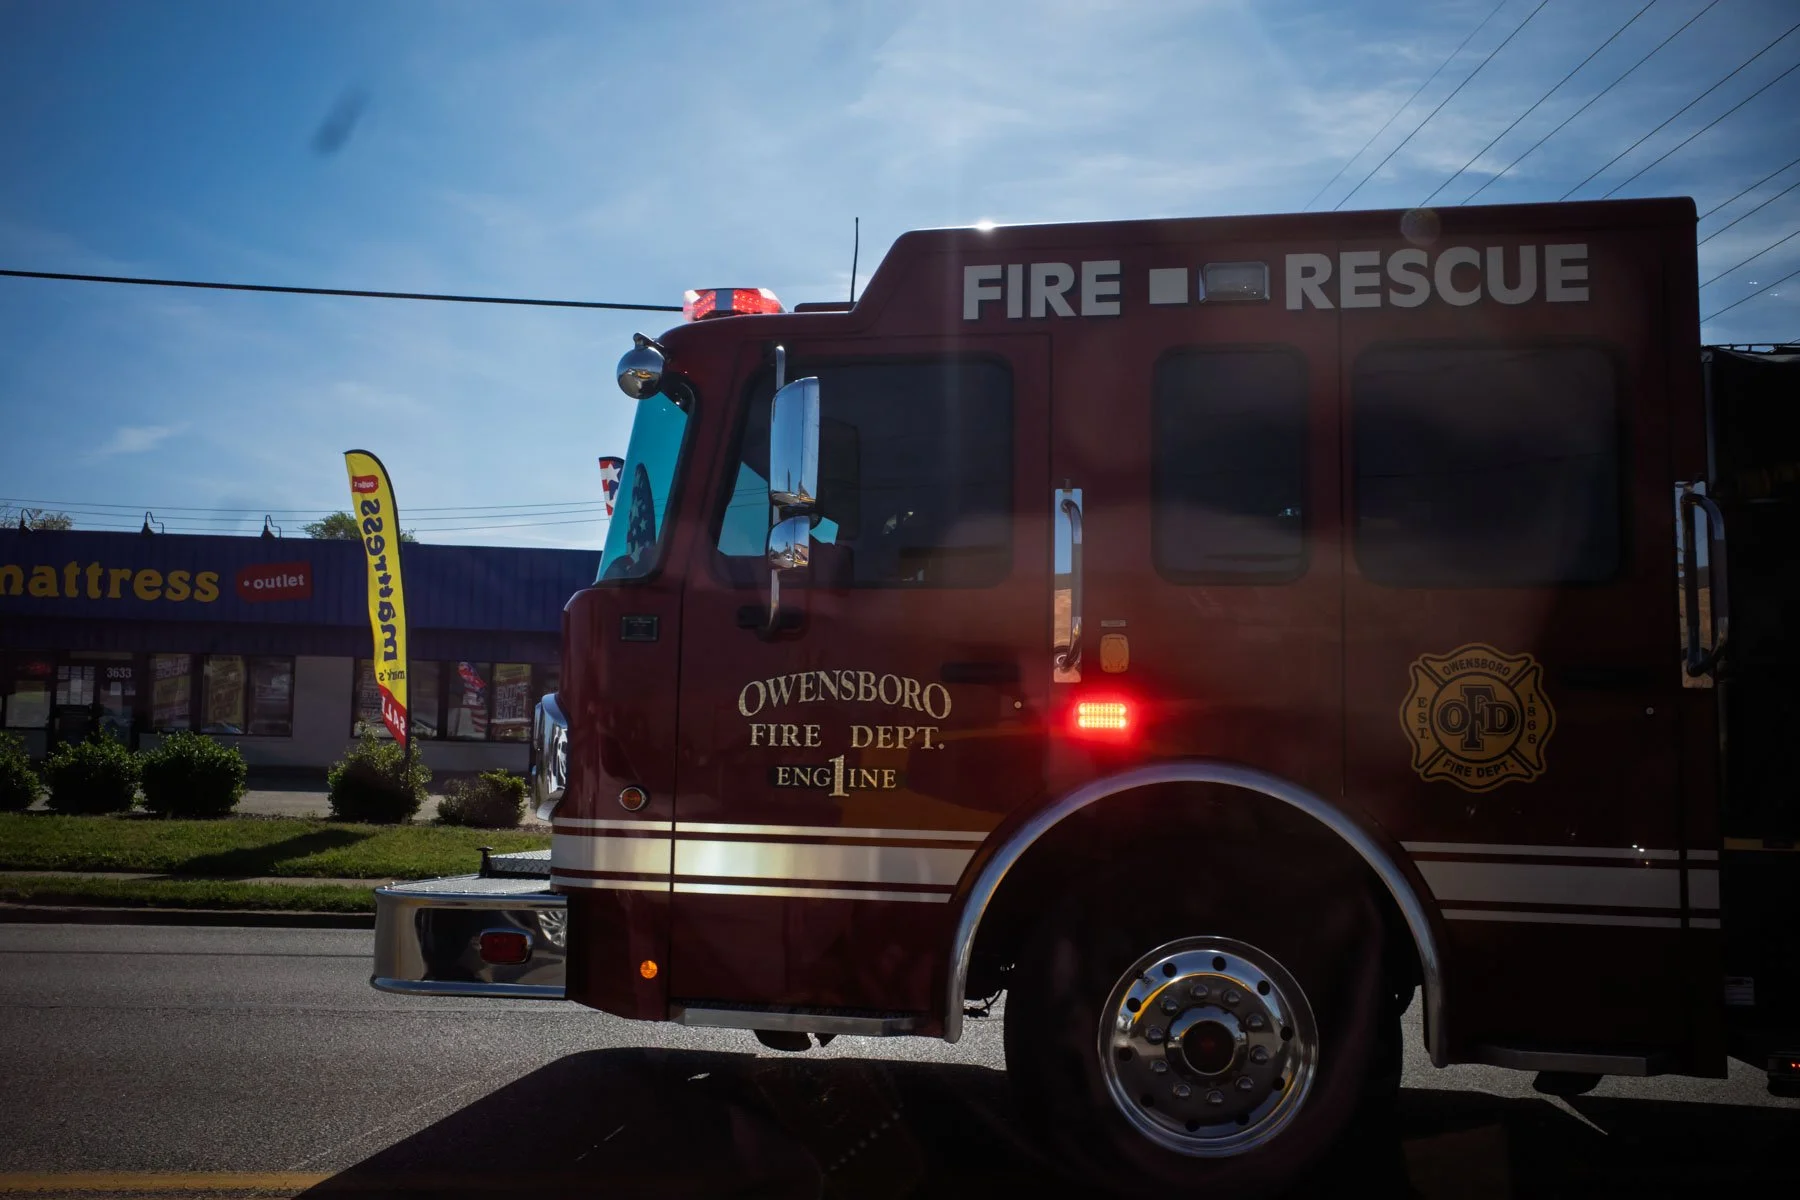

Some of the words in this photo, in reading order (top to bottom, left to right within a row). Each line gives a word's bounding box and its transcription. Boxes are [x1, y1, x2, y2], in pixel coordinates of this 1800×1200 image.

[963, 260, 1121, 320] FIRE
[1285, 243, 1590, 311] RESCUE
[253, 574, 305, 590] outlet
[106, 666, 132, 679] 3633
[1442, 658, 1511, 677] OWENSBORO
[738, 670, 952, 719] OWENSBORO
[1526, 693, 1537, 744] 1866
[749, 723, 822, 747] FIRE
[850, 725, 945, 750] DEPT.
[1442, 759, 1473, 777] FIRE
[1476, 761, 1515, 778] DEPT.
